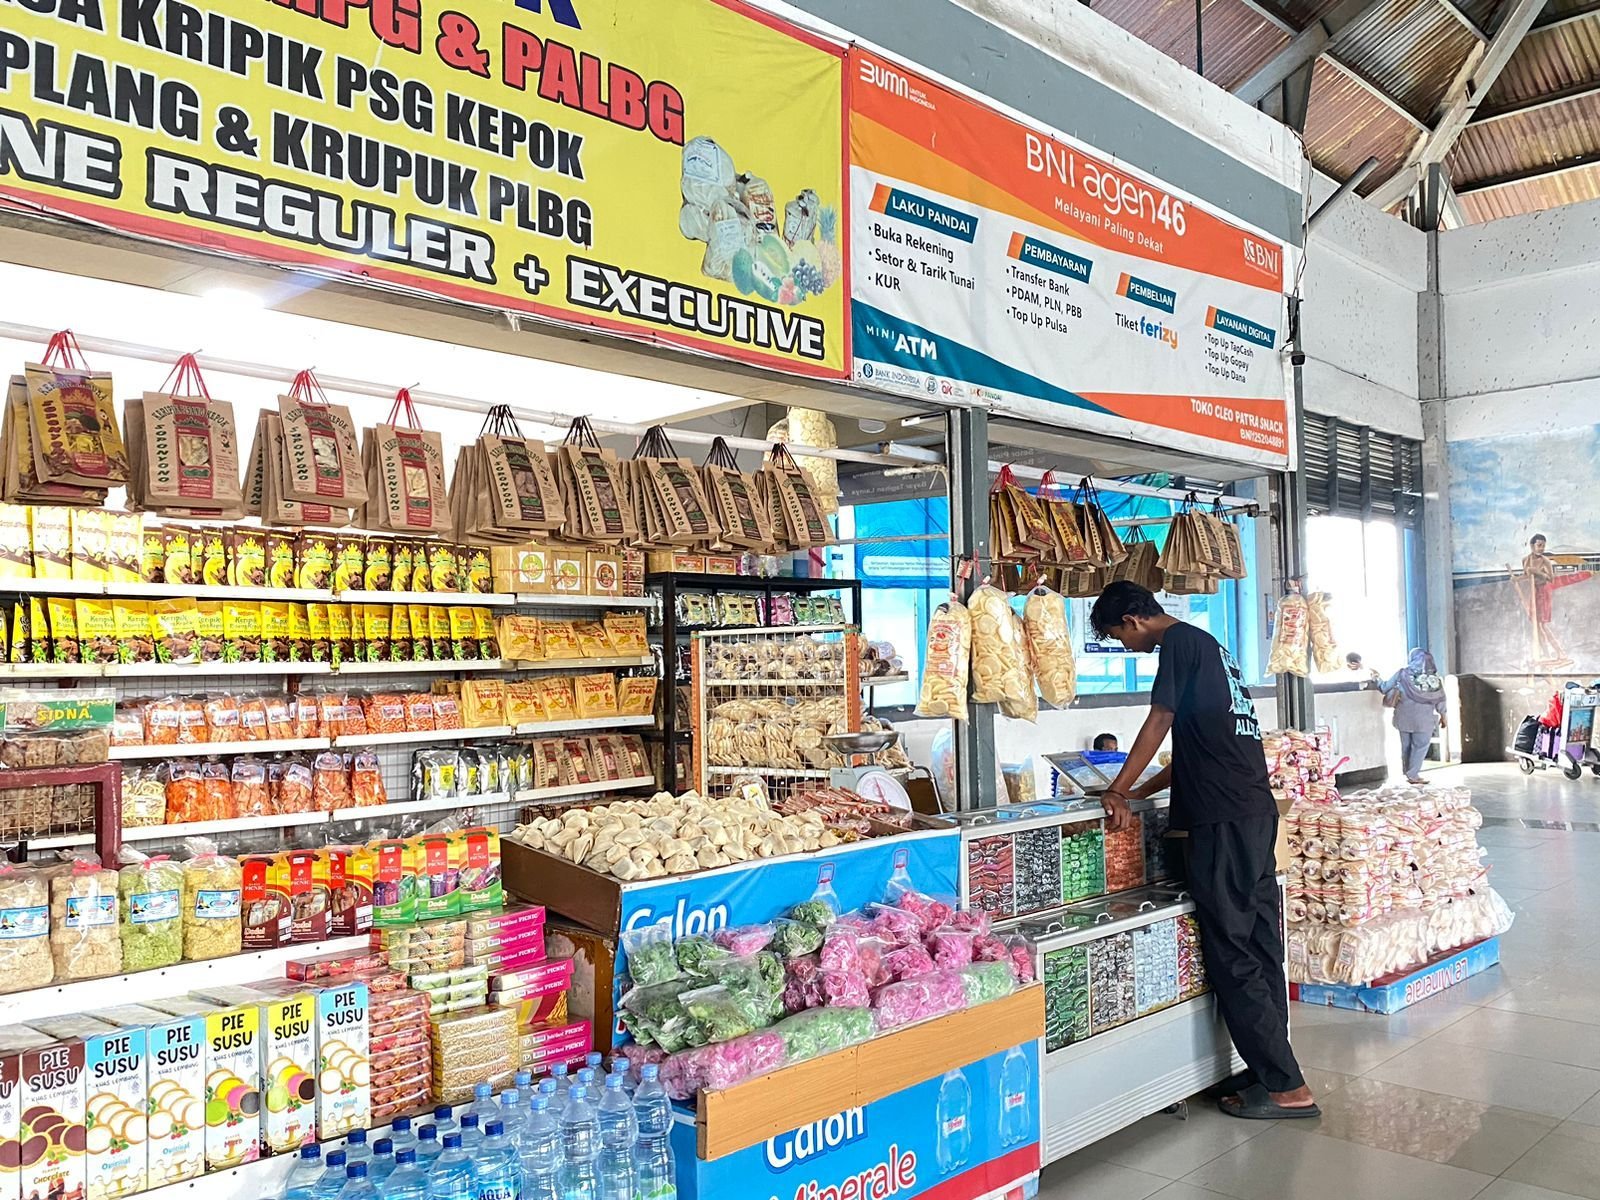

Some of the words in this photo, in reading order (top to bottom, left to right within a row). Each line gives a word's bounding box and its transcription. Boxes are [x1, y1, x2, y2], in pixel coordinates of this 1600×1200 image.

[121, 0, 323, 100] KRIPIK
[337, 56, 433, 134] PSG
[447, 93, 584, 180] KEPOK
[435, 10, 491, 78] &
[501, 22, 685, 146] PALBG
[1025, 133, 1075, 188] BNI
[216, 107, 260, 157] &
[273, 112, 477, 215] KRUPUK
[489, 175, 593, 247] PLBG
[892, 196, 925, 218] LAKU
[928, 207, 970, 234] PANDAI
[1054, 196, 1101, 228] Melayani
[1104, 216, 1135, 244] Paling
[1137, 230, 1164, 254] Dekat
[146, 148, 497, 284] REGULER
[567, 257, 824, 360] EXECUTIVE
[874, 224, 902, 244] Buka
[906, 233, 954, 263] Rekening
[875, 248, 904, 270] Setor
[907, 258, 917, 272] &
[920, 261, 947, 281] Tarik
[949, 270, 975, 290] Tunai
[1024, 242, 1087, 277] PEMBAYARAN
[1255, 242, 1278, 274] BNI
[875, 272, 901, 291] KUR
[1011, 265, 1046, 289] Transfer
[1049, 278, 1070, 296] Bank
[1130, 282, 1173, 307] PEMBELIAN
[1011, 287, 1042, 308] PDAM,
[1044, 298, 1063, 315] PLN,
[1066, 303, 1082, 318] PBB
[1011, 306, 1028, 324] Top
[1030, 314, 1043, 328] Up
[1045, 317, 1067, 334] Pulsa
[1115, 312, 1138, 332] Tiket
[1139, 315, 1178, 350] ferizy
[1216, 313, 1247, 335] LAYANAN
[1248, 326, 1272, 343] DIGITAL
[867, 324, 895, 340] MINI
[894, 333, 937, 361] ATM
[1208, 333, 1219, 345] Top
[1221, 338, 1229, 349] Up
[1230, 340, 1254, 358] TapCash
[1208, 348, 1219, 360] Top
[1221, 353, 1229, 363] Up
[1230, 356, 1249, 372] Gopay
[1208, 362, 1219, 376] Top
[1221, 368, 1230, 379] Up
[1230, 370, 1246, 384] Dana
[1190, 398, 1213, 416] TOKO
[1214, 405, 1234, 422] CLEO
[1235, 410, 1259, 428] PATRA
[1259, 417, 1284, 435] SNACK
[282, 1003, 303, 1021] PIE
[335, 991, 356, 1008] PIE
[221, 1013, 245, 1032] PIE
[274, 1019, 309, 1041] SUSU
[326, 1007, 363, 1027] SUSU
[104, 1037, 130, 1057] PIE
[167, 1025, 191, 1043] PIE
[213, 1031, 253, 1052] SUSU
[40, 1048, 70, 1071] PIE
[94, 1054, 139, 1079] SUSU
[157, 1043, 199, 1066] SUSU
[30, 1066, 80, 1093] SUSU
